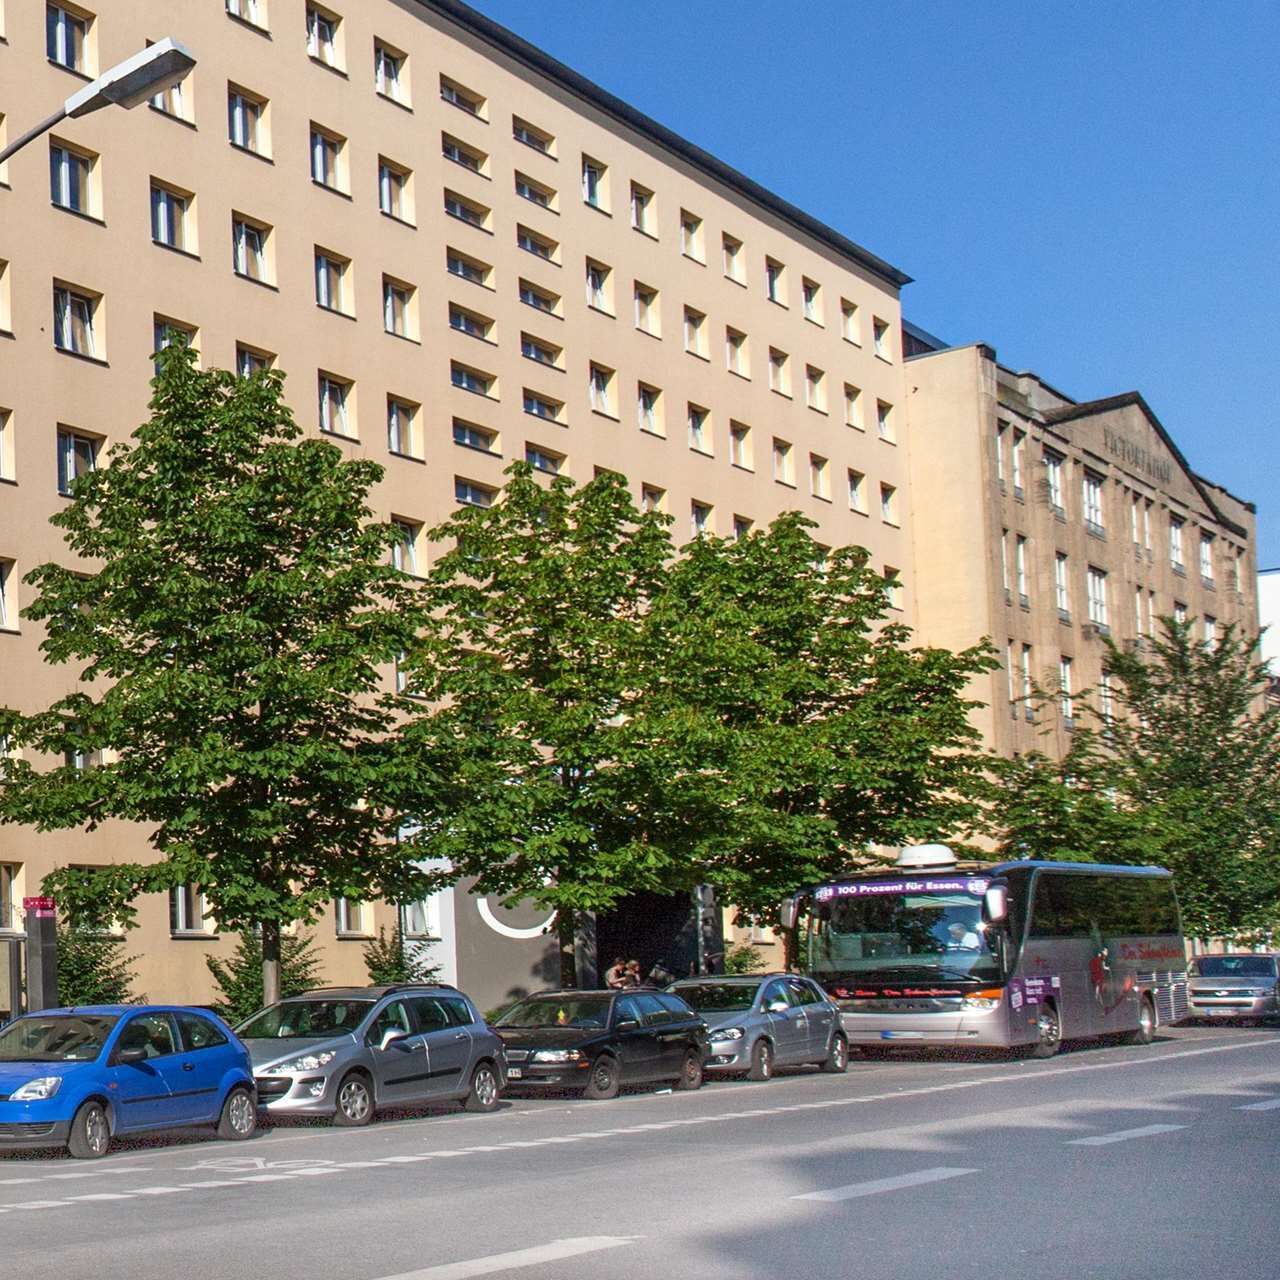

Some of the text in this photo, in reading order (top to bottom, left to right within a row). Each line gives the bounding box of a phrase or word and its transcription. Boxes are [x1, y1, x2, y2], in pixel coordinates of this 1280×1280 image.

[837, 886, 857, 894] 100
[860, 884, 903, 893] Prozent
[905, 881, 923, 891] für
[926, 881, 964, 890] Essen.
